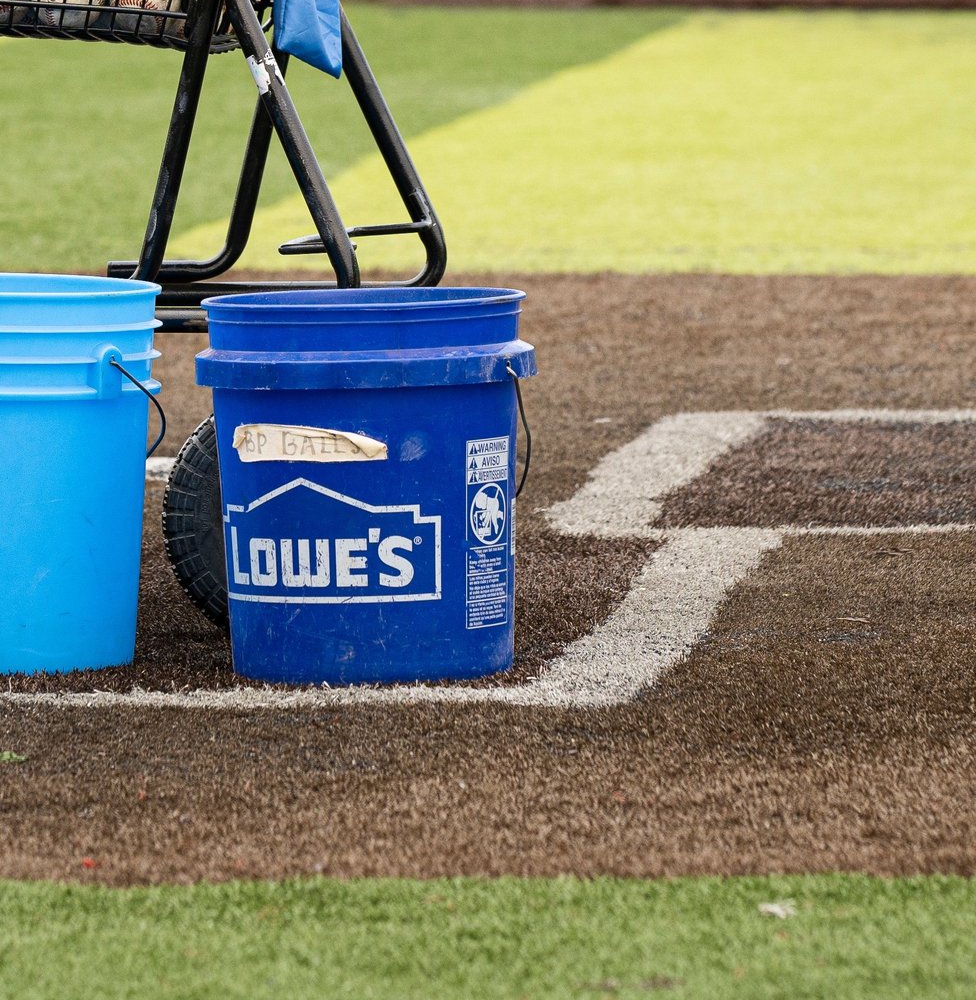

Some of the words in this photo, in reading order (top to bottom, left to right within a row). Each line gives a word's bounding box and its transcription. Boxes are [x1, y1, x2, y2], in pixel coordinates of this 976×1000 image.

[245, 430, 267, 454] BP
[478, 440, 507, 453] WARNING
[481, 455, 501, 467] AVISO
[230, 526, 415, 588] LOWE'S
